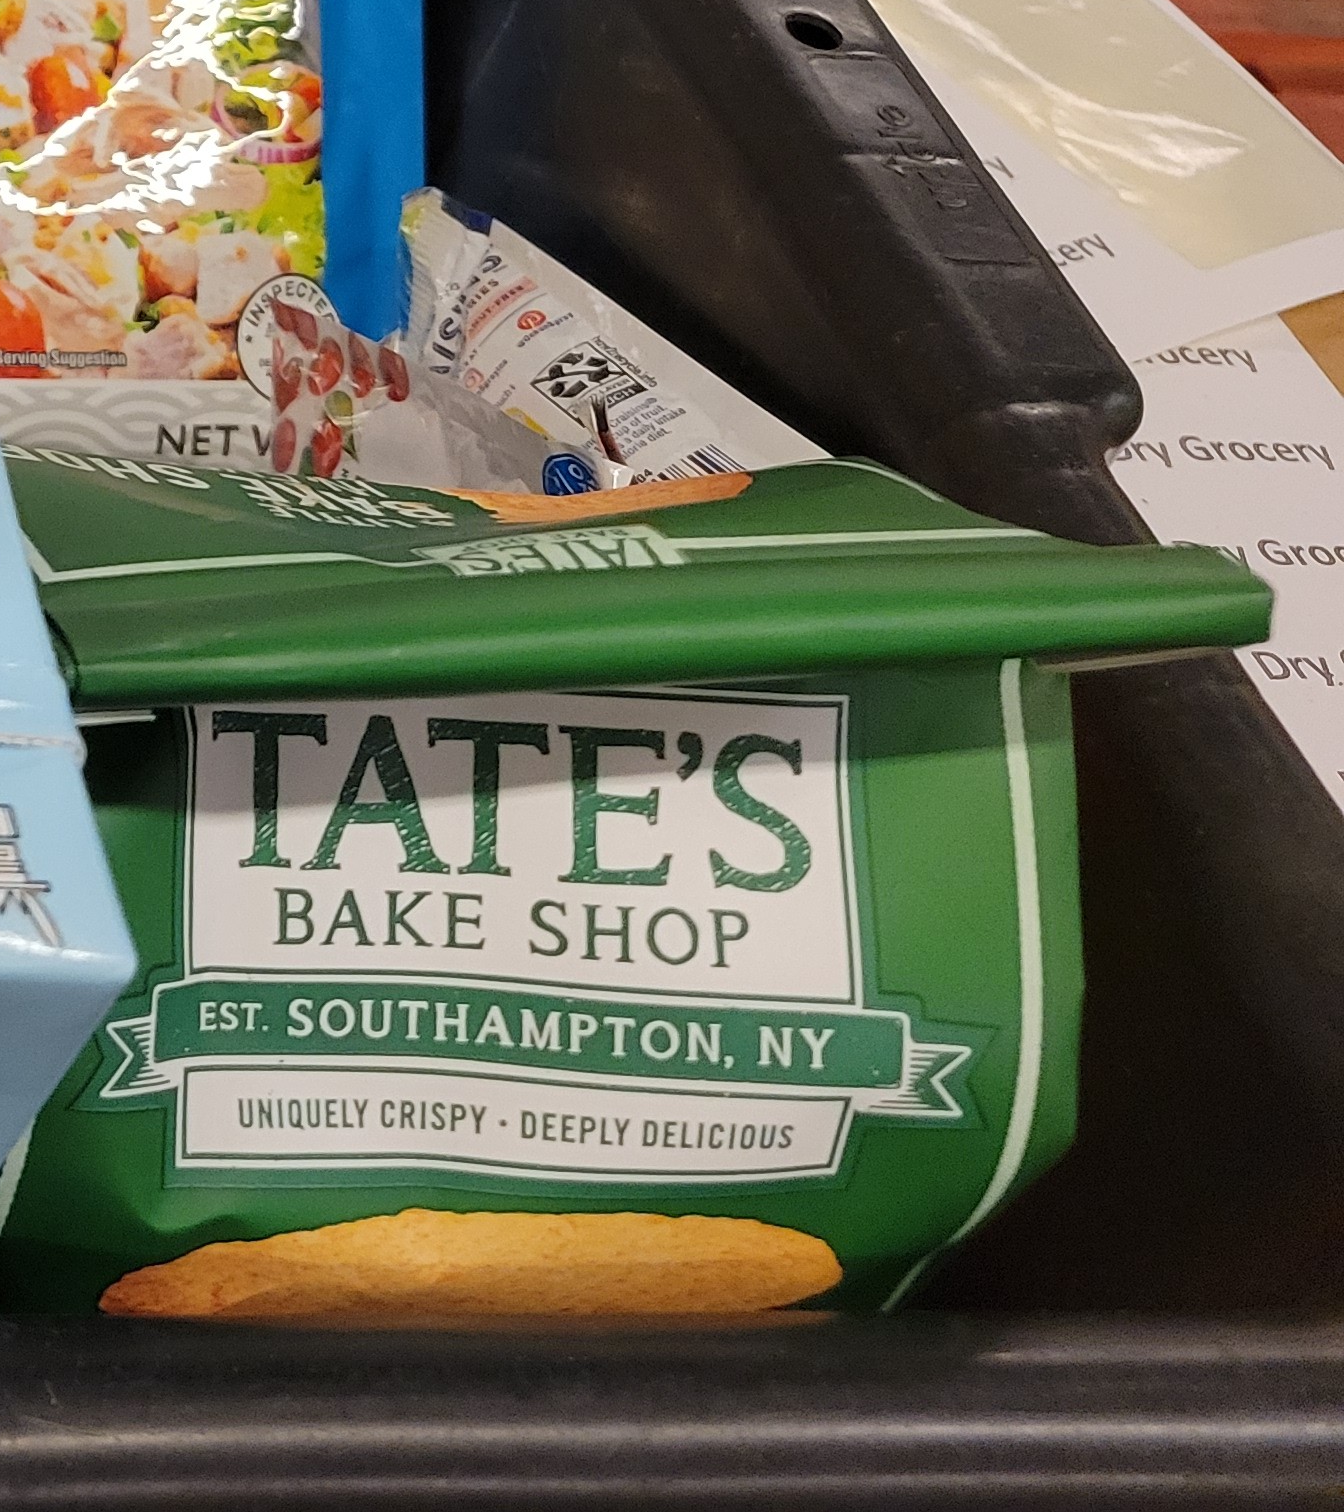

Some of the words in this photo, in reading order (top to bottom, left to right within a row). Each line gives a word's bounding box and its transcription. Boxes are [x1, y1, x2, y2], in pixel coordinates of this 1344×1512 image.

[48, 349, 127, 368] Suggestion
[156, 423, 240, 457] NET
[1178, 434, 1336, 472] Grocery
[1251, 649, 1335, 688] Dry
[211, 709, 814, 894] TATE'S
[272, 887, 487, 953] BAKE
[528, 898, 752, 971] SHOP
[198, 999, 270, 1035] EST.
[286, 996, 739, 1073] SOUTHAMPTON,
[754, 1024, 837, 1072] NY
[237, 1096, 368, 1132] UNIQUELY
[379, 1099, 488, 1138] CRISPY
[519, 1113, 632, 1152] DEEPLY
[641, 1119, 795, 1152] DELICIOUS
